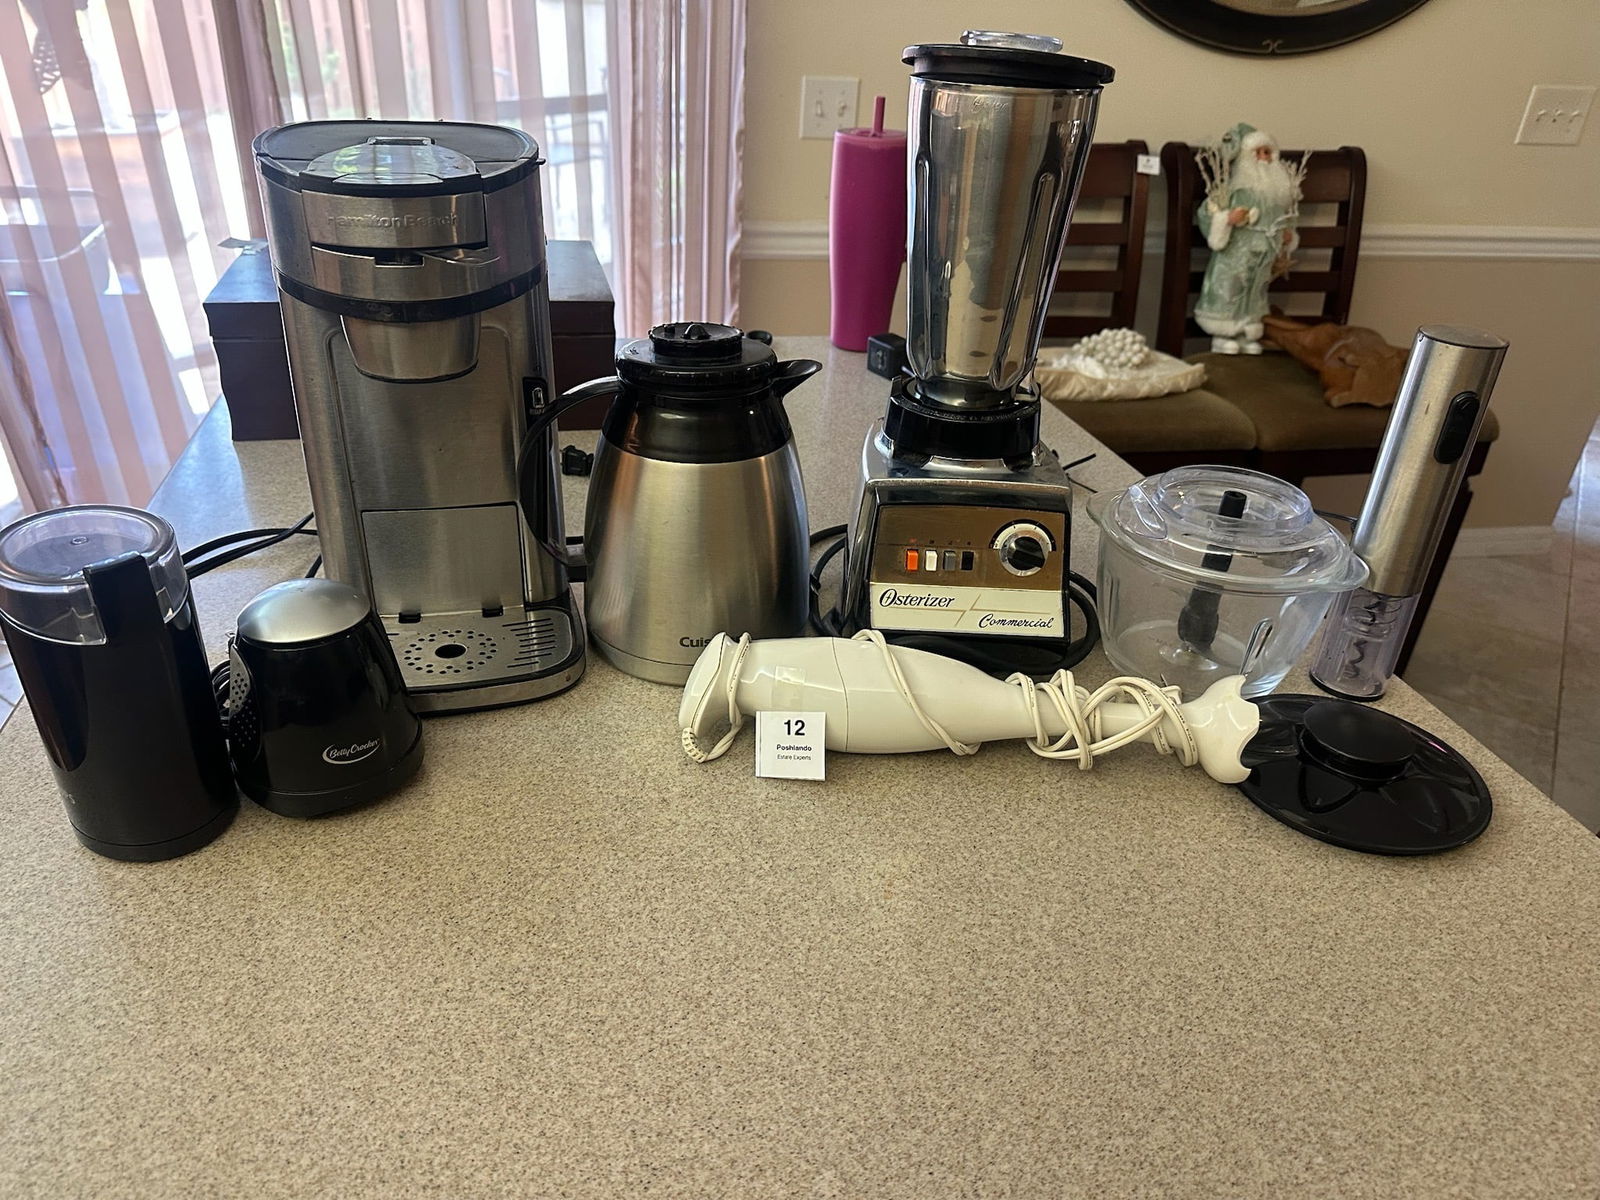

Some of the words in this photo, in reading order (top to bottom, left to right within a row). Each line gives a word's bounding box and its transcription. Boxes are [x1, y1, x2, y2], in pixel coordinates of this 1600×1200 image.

[327, 213, 400, 228] Hamilton
[404, 212, 458, 227] Beach
[879, 588, 955, 607] Osterizer
[978, 613, 1055, 629] Commercial
[783, 719, 806, 736] 12
[330, 748, 350, 759] Betty
[350, 739, 378, 754] Crocker
[776, 743, 813, 752] Poshlando
